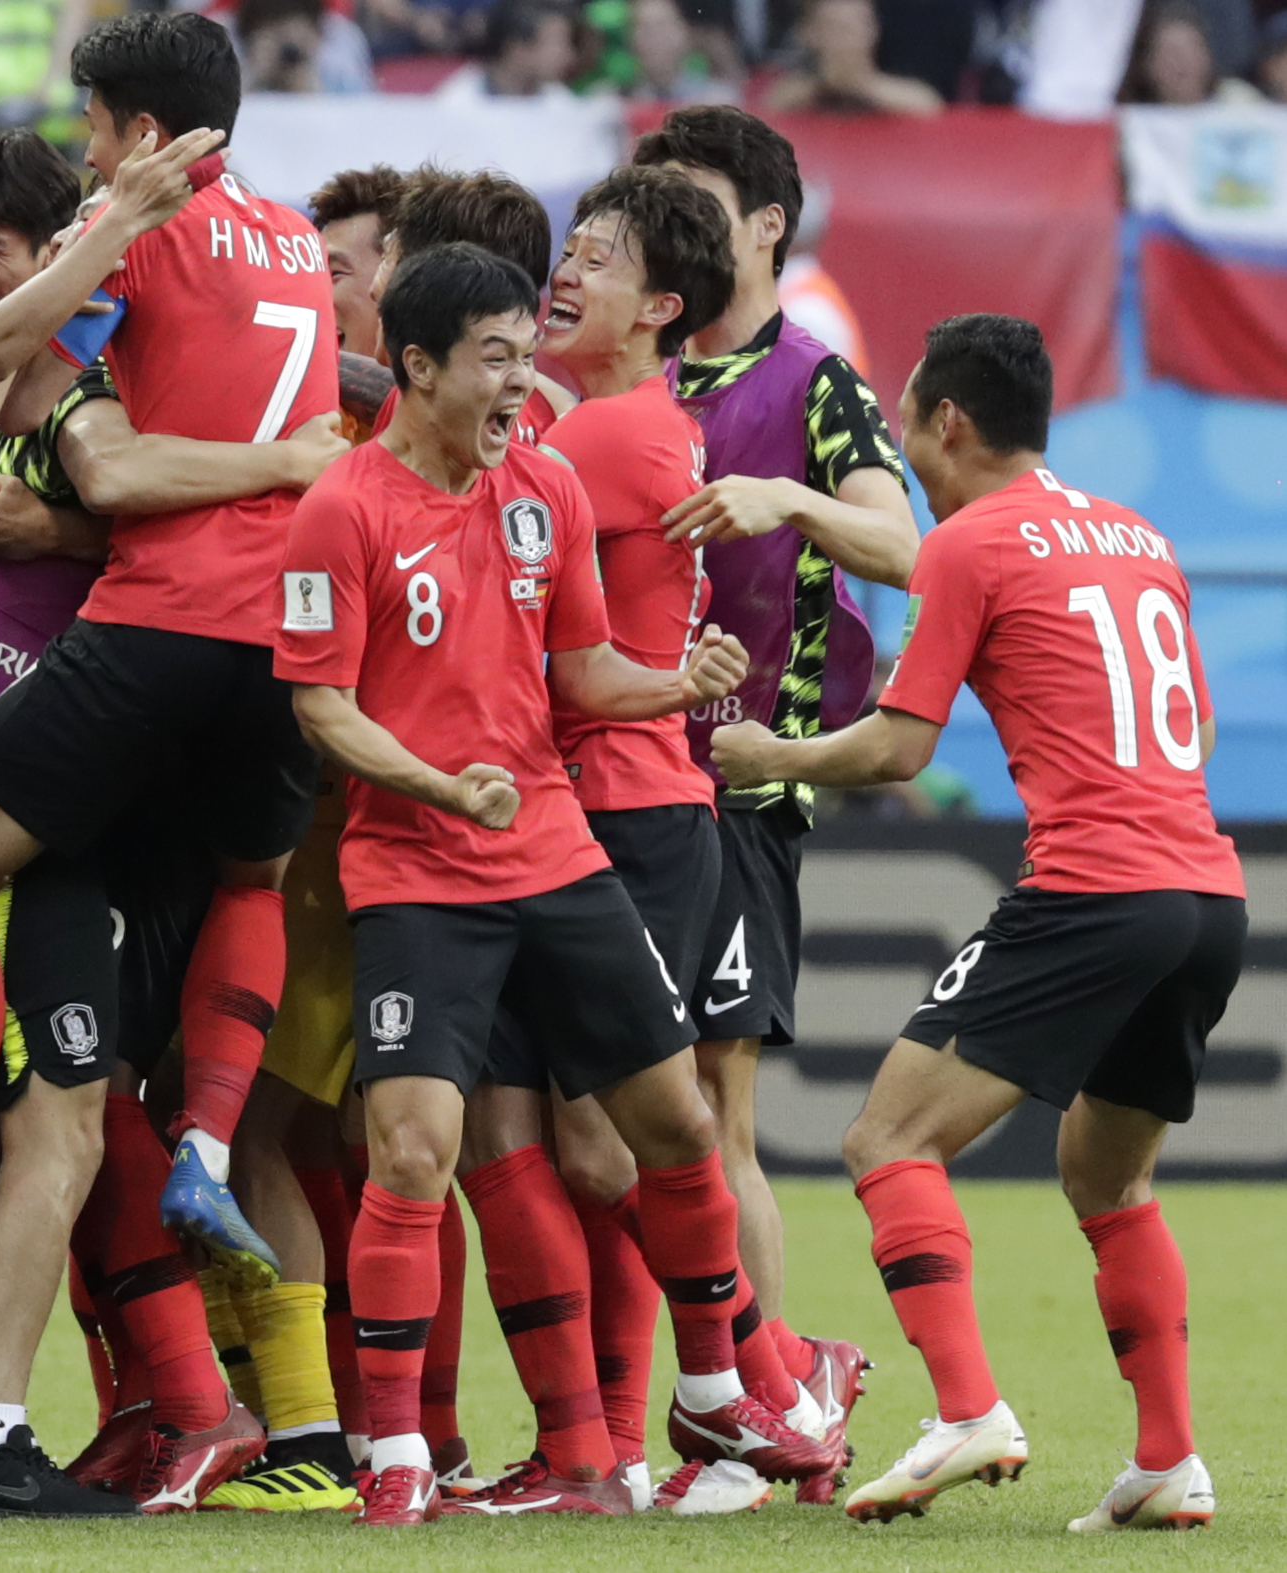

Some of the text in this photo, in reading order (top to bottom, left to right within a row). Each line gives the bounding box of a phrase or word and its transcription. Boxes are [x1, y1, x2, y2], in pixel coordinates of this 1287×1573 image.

[210, 217, 326, 275] H M SON
[252, 300, 317, 443] 7
[1019, 522, 1051, 558] S
[1050, 519, 1090, 554] M
[407, 571, 442, 647] 8
[1068, 584, 1201, 771] 18
[713, 914, 752, 990] 4
